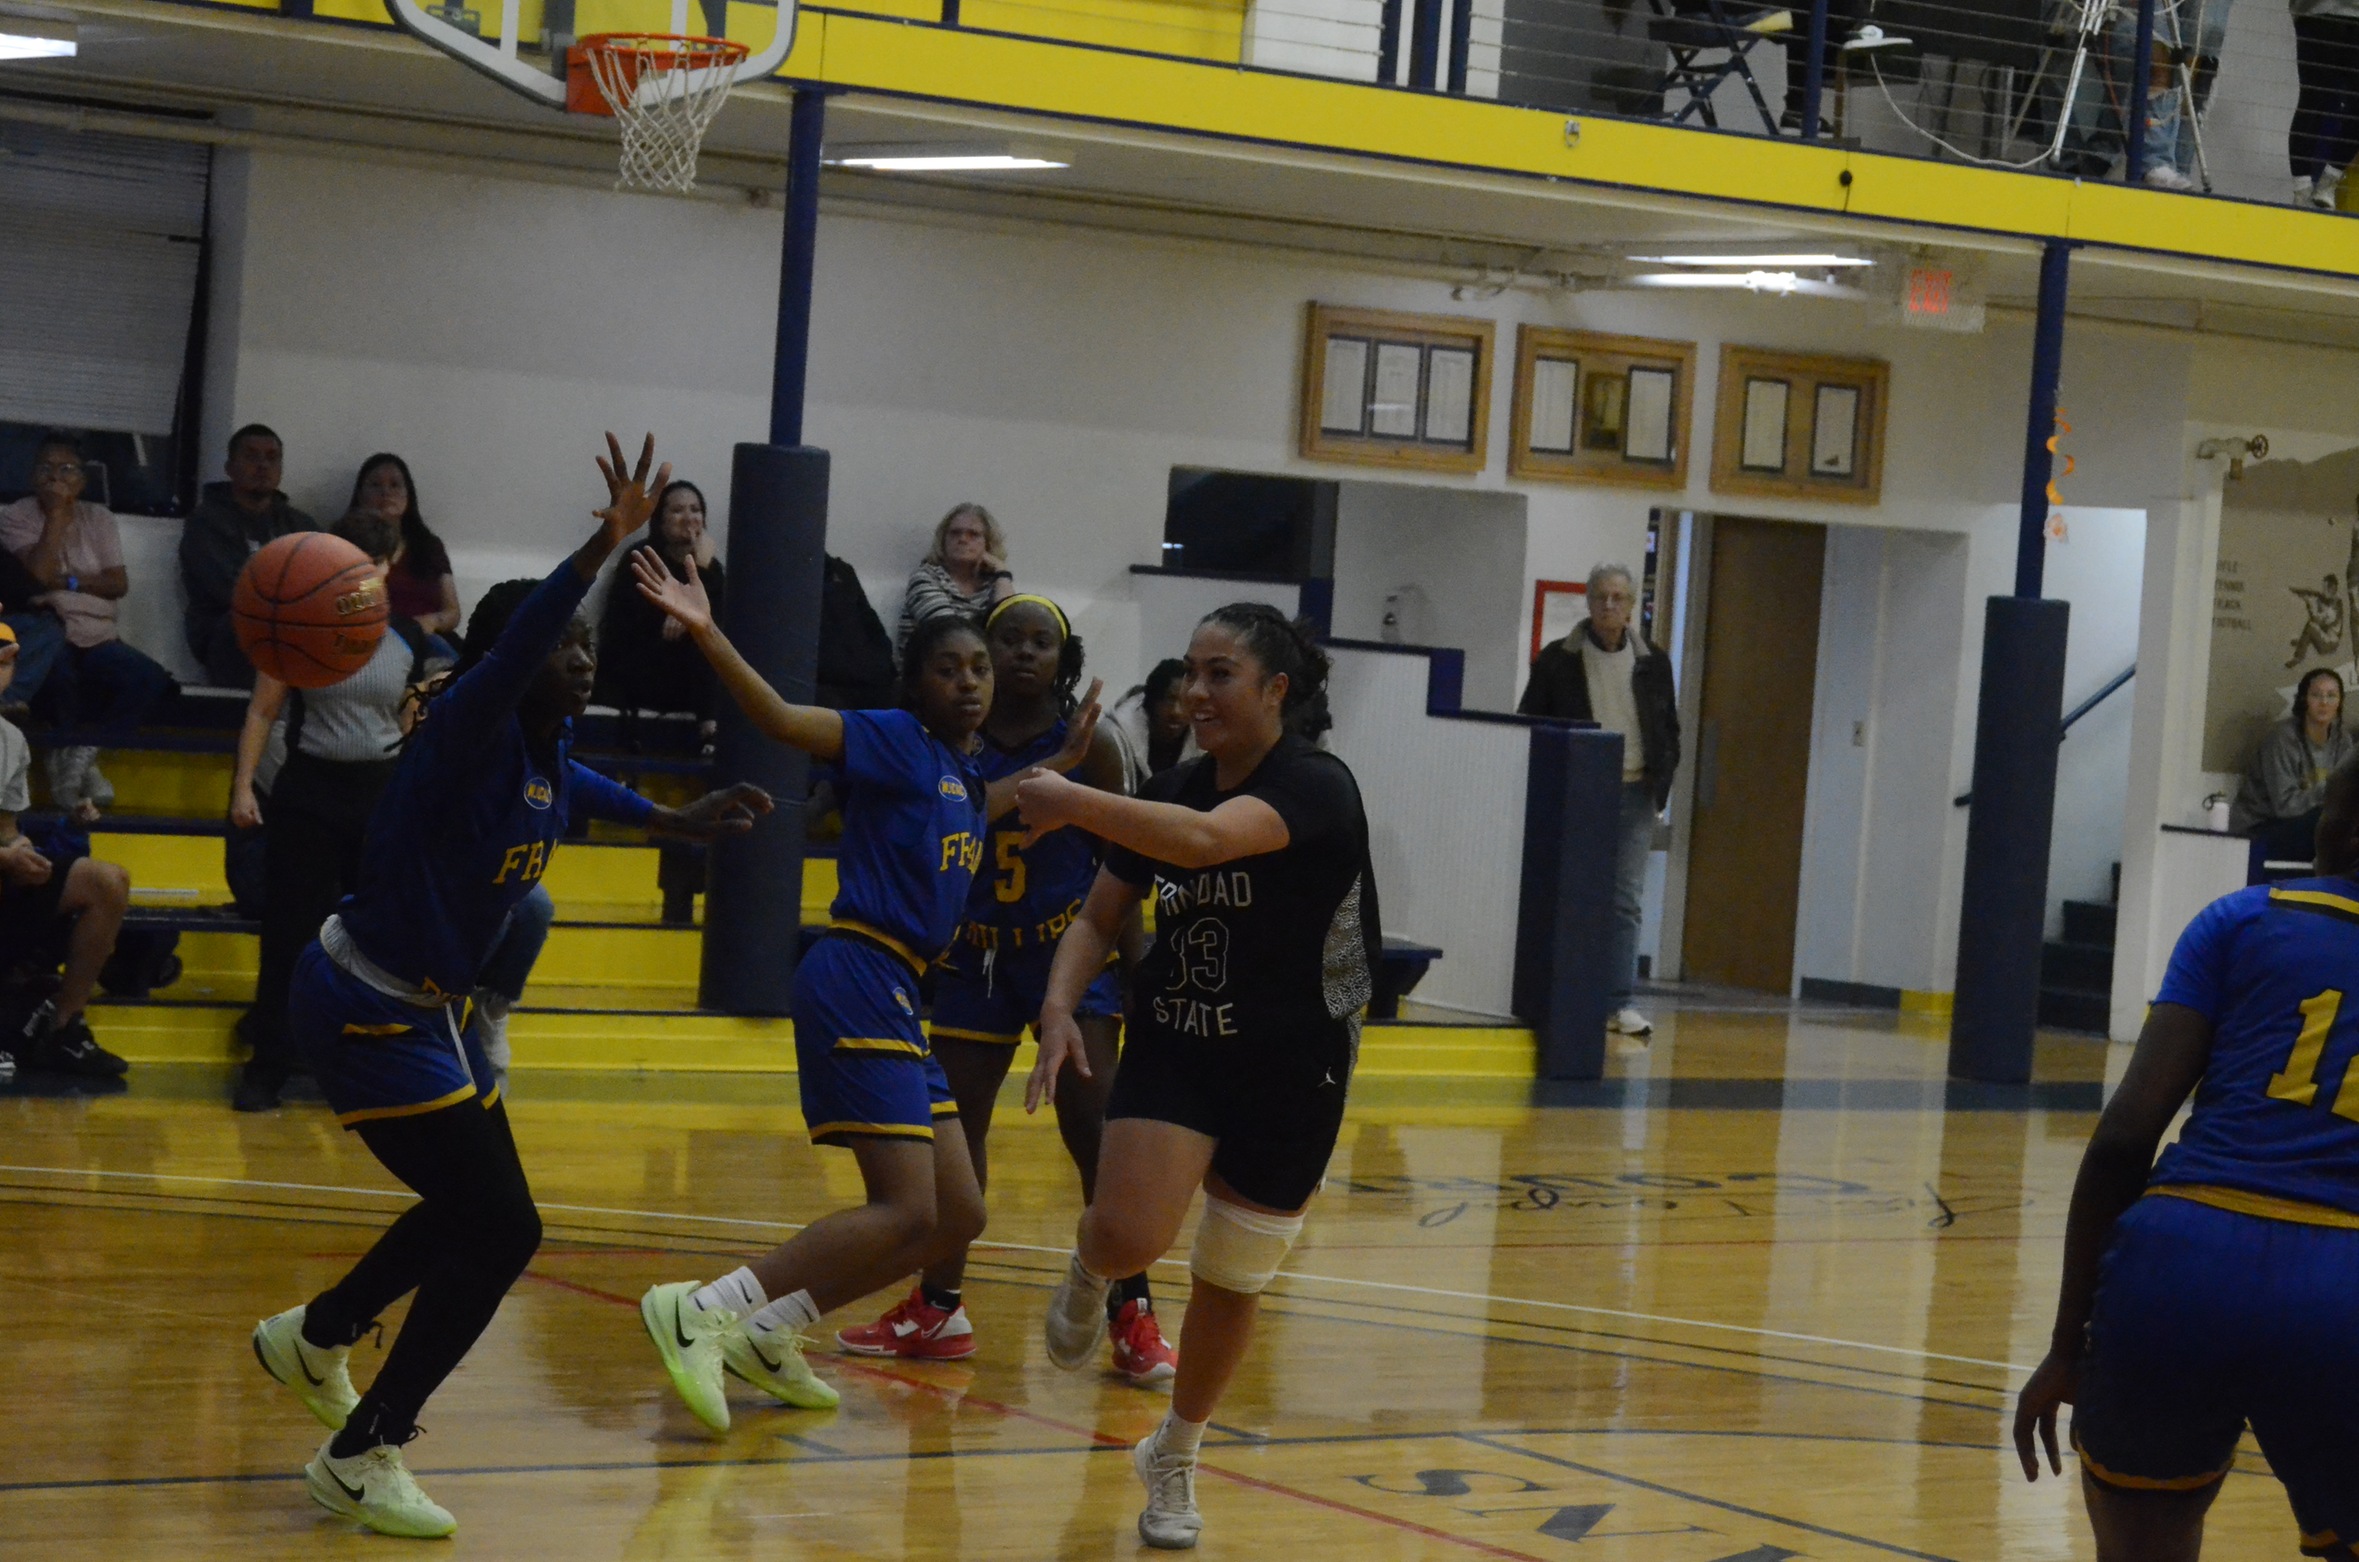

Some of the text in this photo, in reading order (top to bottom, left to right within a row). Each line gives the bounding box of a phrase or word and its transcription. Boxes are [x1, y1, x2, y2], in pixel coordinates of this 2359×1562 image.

[1908, 268, 1953, 314] EXIT
[994, 830, 1026, 903] 5
[1154, 871, 1252, 916] TRNDAD
[1153, 996, 1239, 1038] STATE
